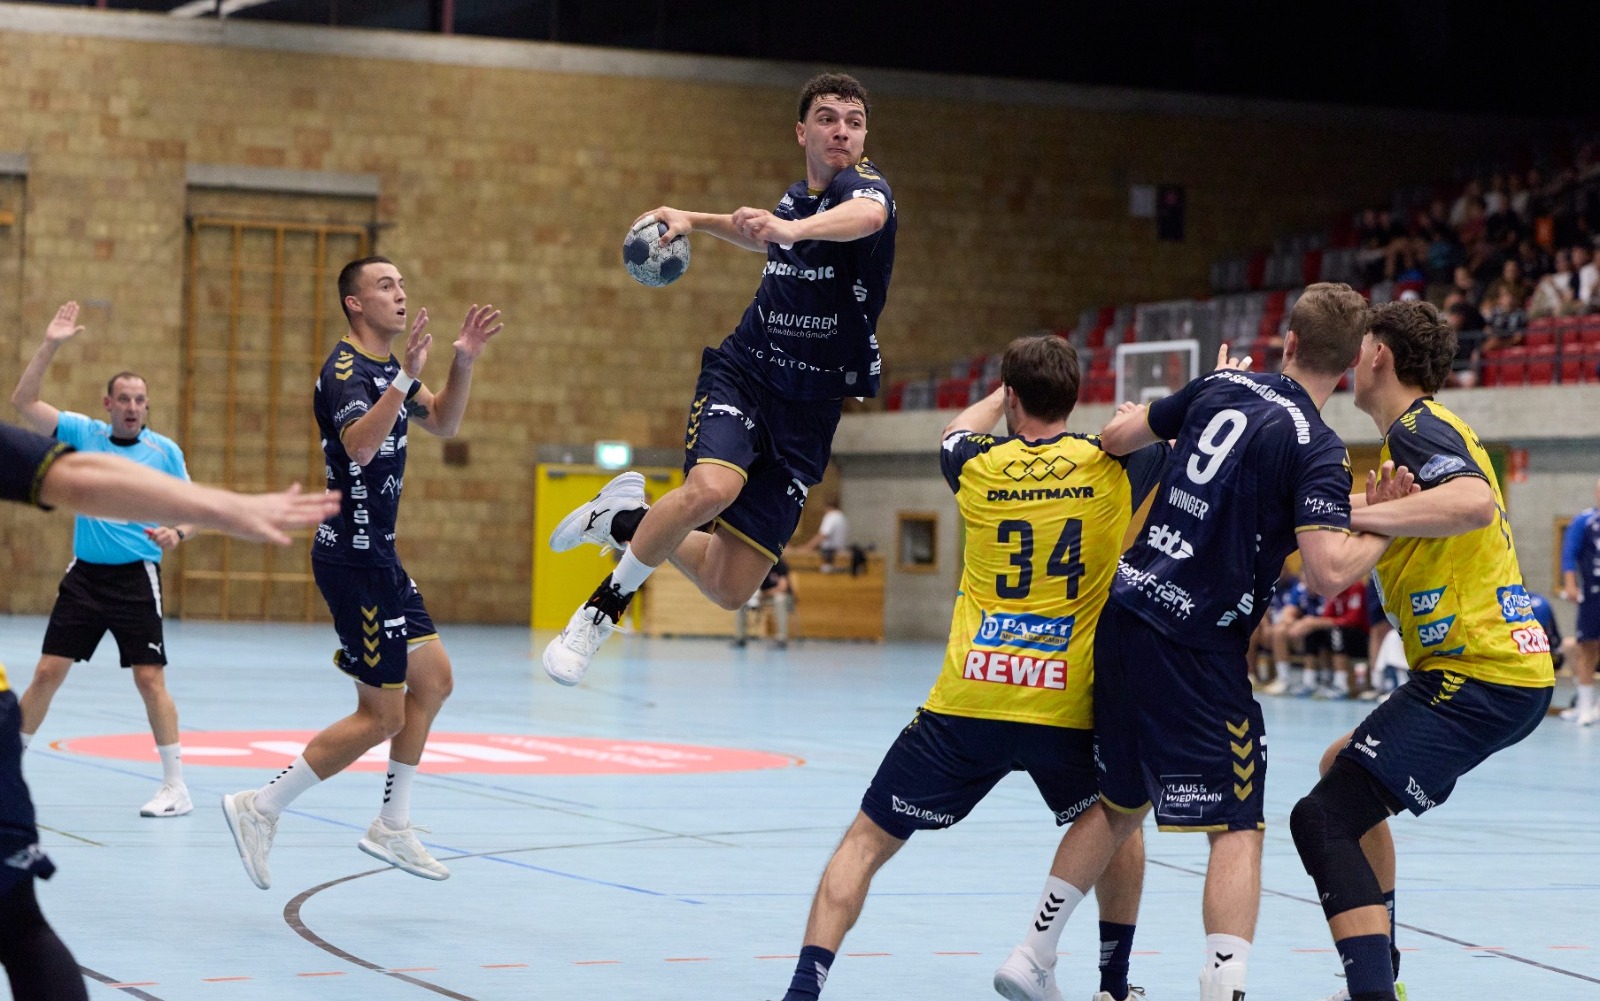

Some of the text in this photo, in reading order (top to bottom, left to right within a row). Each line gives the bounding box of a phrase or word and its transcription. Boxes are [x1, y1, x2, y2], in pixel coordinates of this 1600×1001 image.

[1186, 408, 1248, 485] 9
[987, 486, 1094, 501] DRAHTMAYR
[1168, 486, 1210, 521] WINGER
[1147, 523, 1181, 555] abt
[995, 518, 1086, 600] 34
[1144, 574, 1195, 615] Frank
[1412, 593, 1441, 612] SAP
[1002, 618, 1071, 636] PABST
[1420, 622, 1450, 644] SAP
[964, 651, 1065, 689] REWE
[1354, 742, 1377, 759] erima
[1166, 793, 1222, 803] WIEDMANN
[1199, 784, 1207, 793] &
[905, 805, 955, 825] DURAVIT
